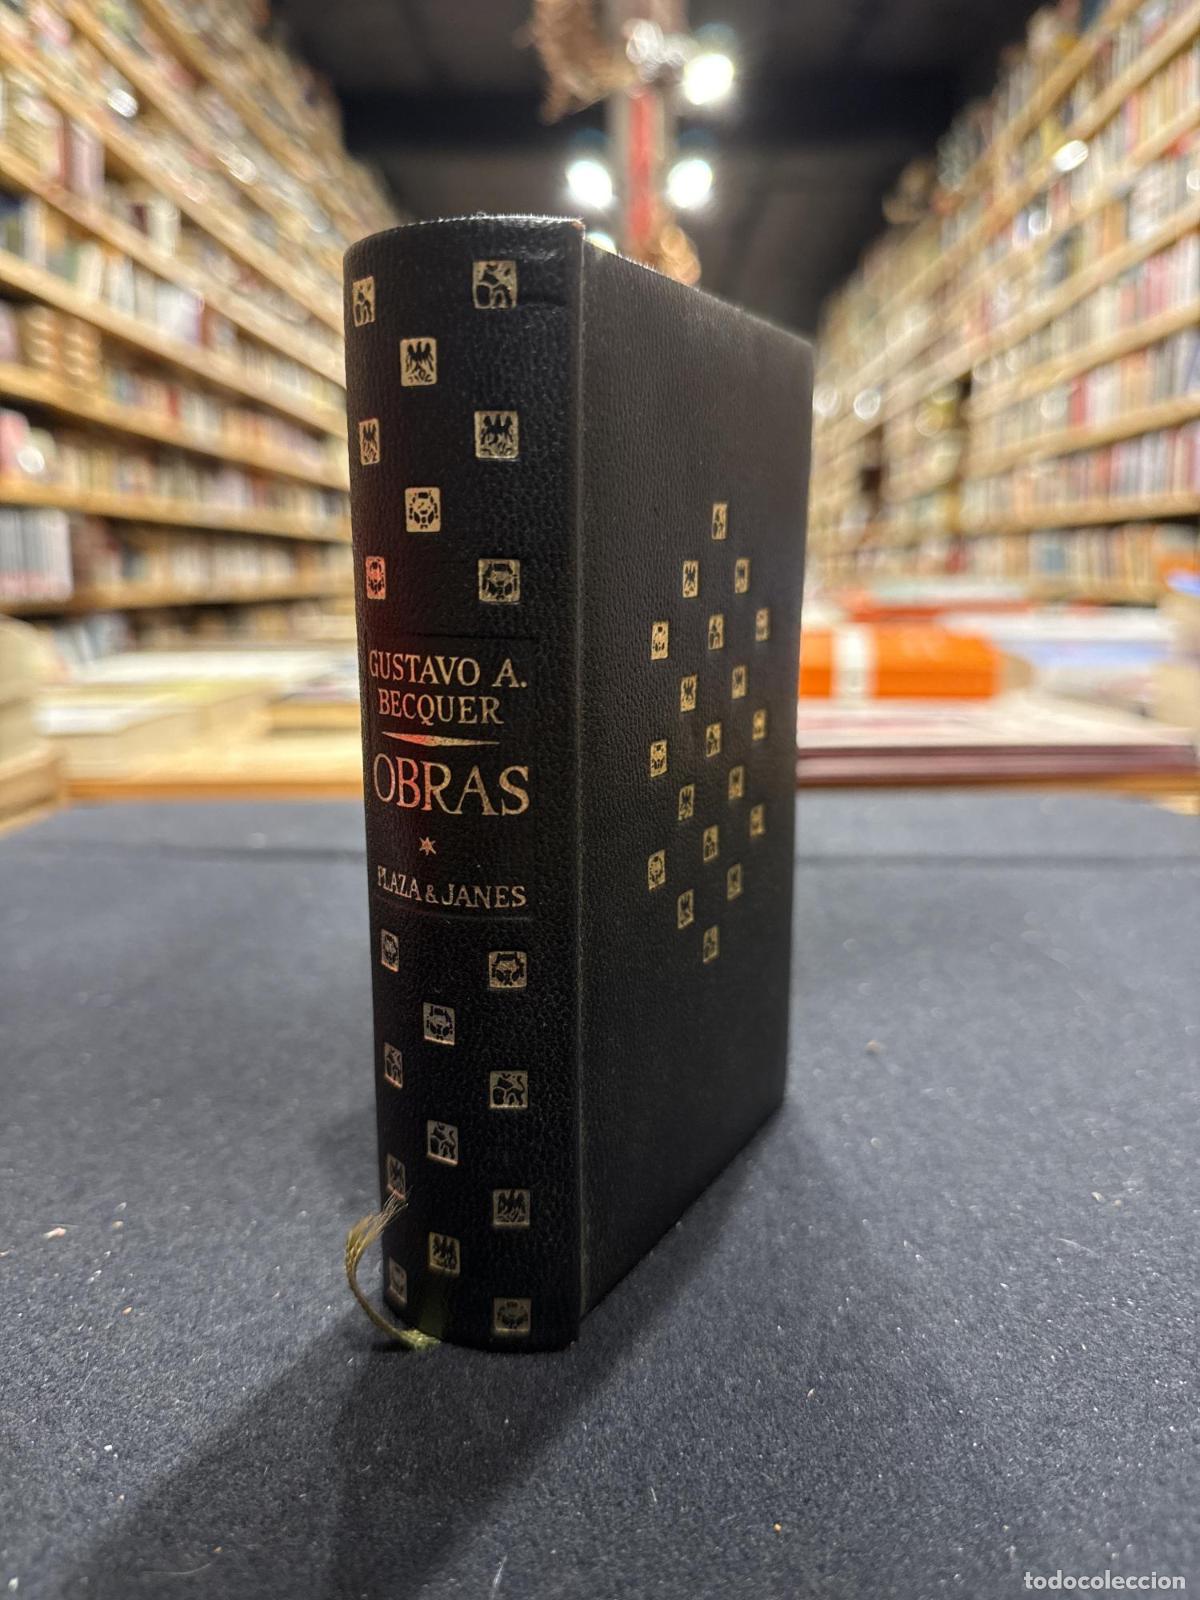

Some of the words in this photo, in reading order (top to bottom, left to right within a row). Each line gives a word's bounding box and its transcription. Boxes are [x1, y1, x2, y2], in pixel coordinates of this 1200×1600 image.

[368, 649, 481, 687] GUSTAVO
[492, 658, 528, 689] A.
[378, 688, 504, 726] BECQUER
[373, 753, 531, 816] OBRAS
[377, 865, 421, 901] PLAZA
[425, 883, 439, 904] &
[441, 882, 527, 909] JANES
